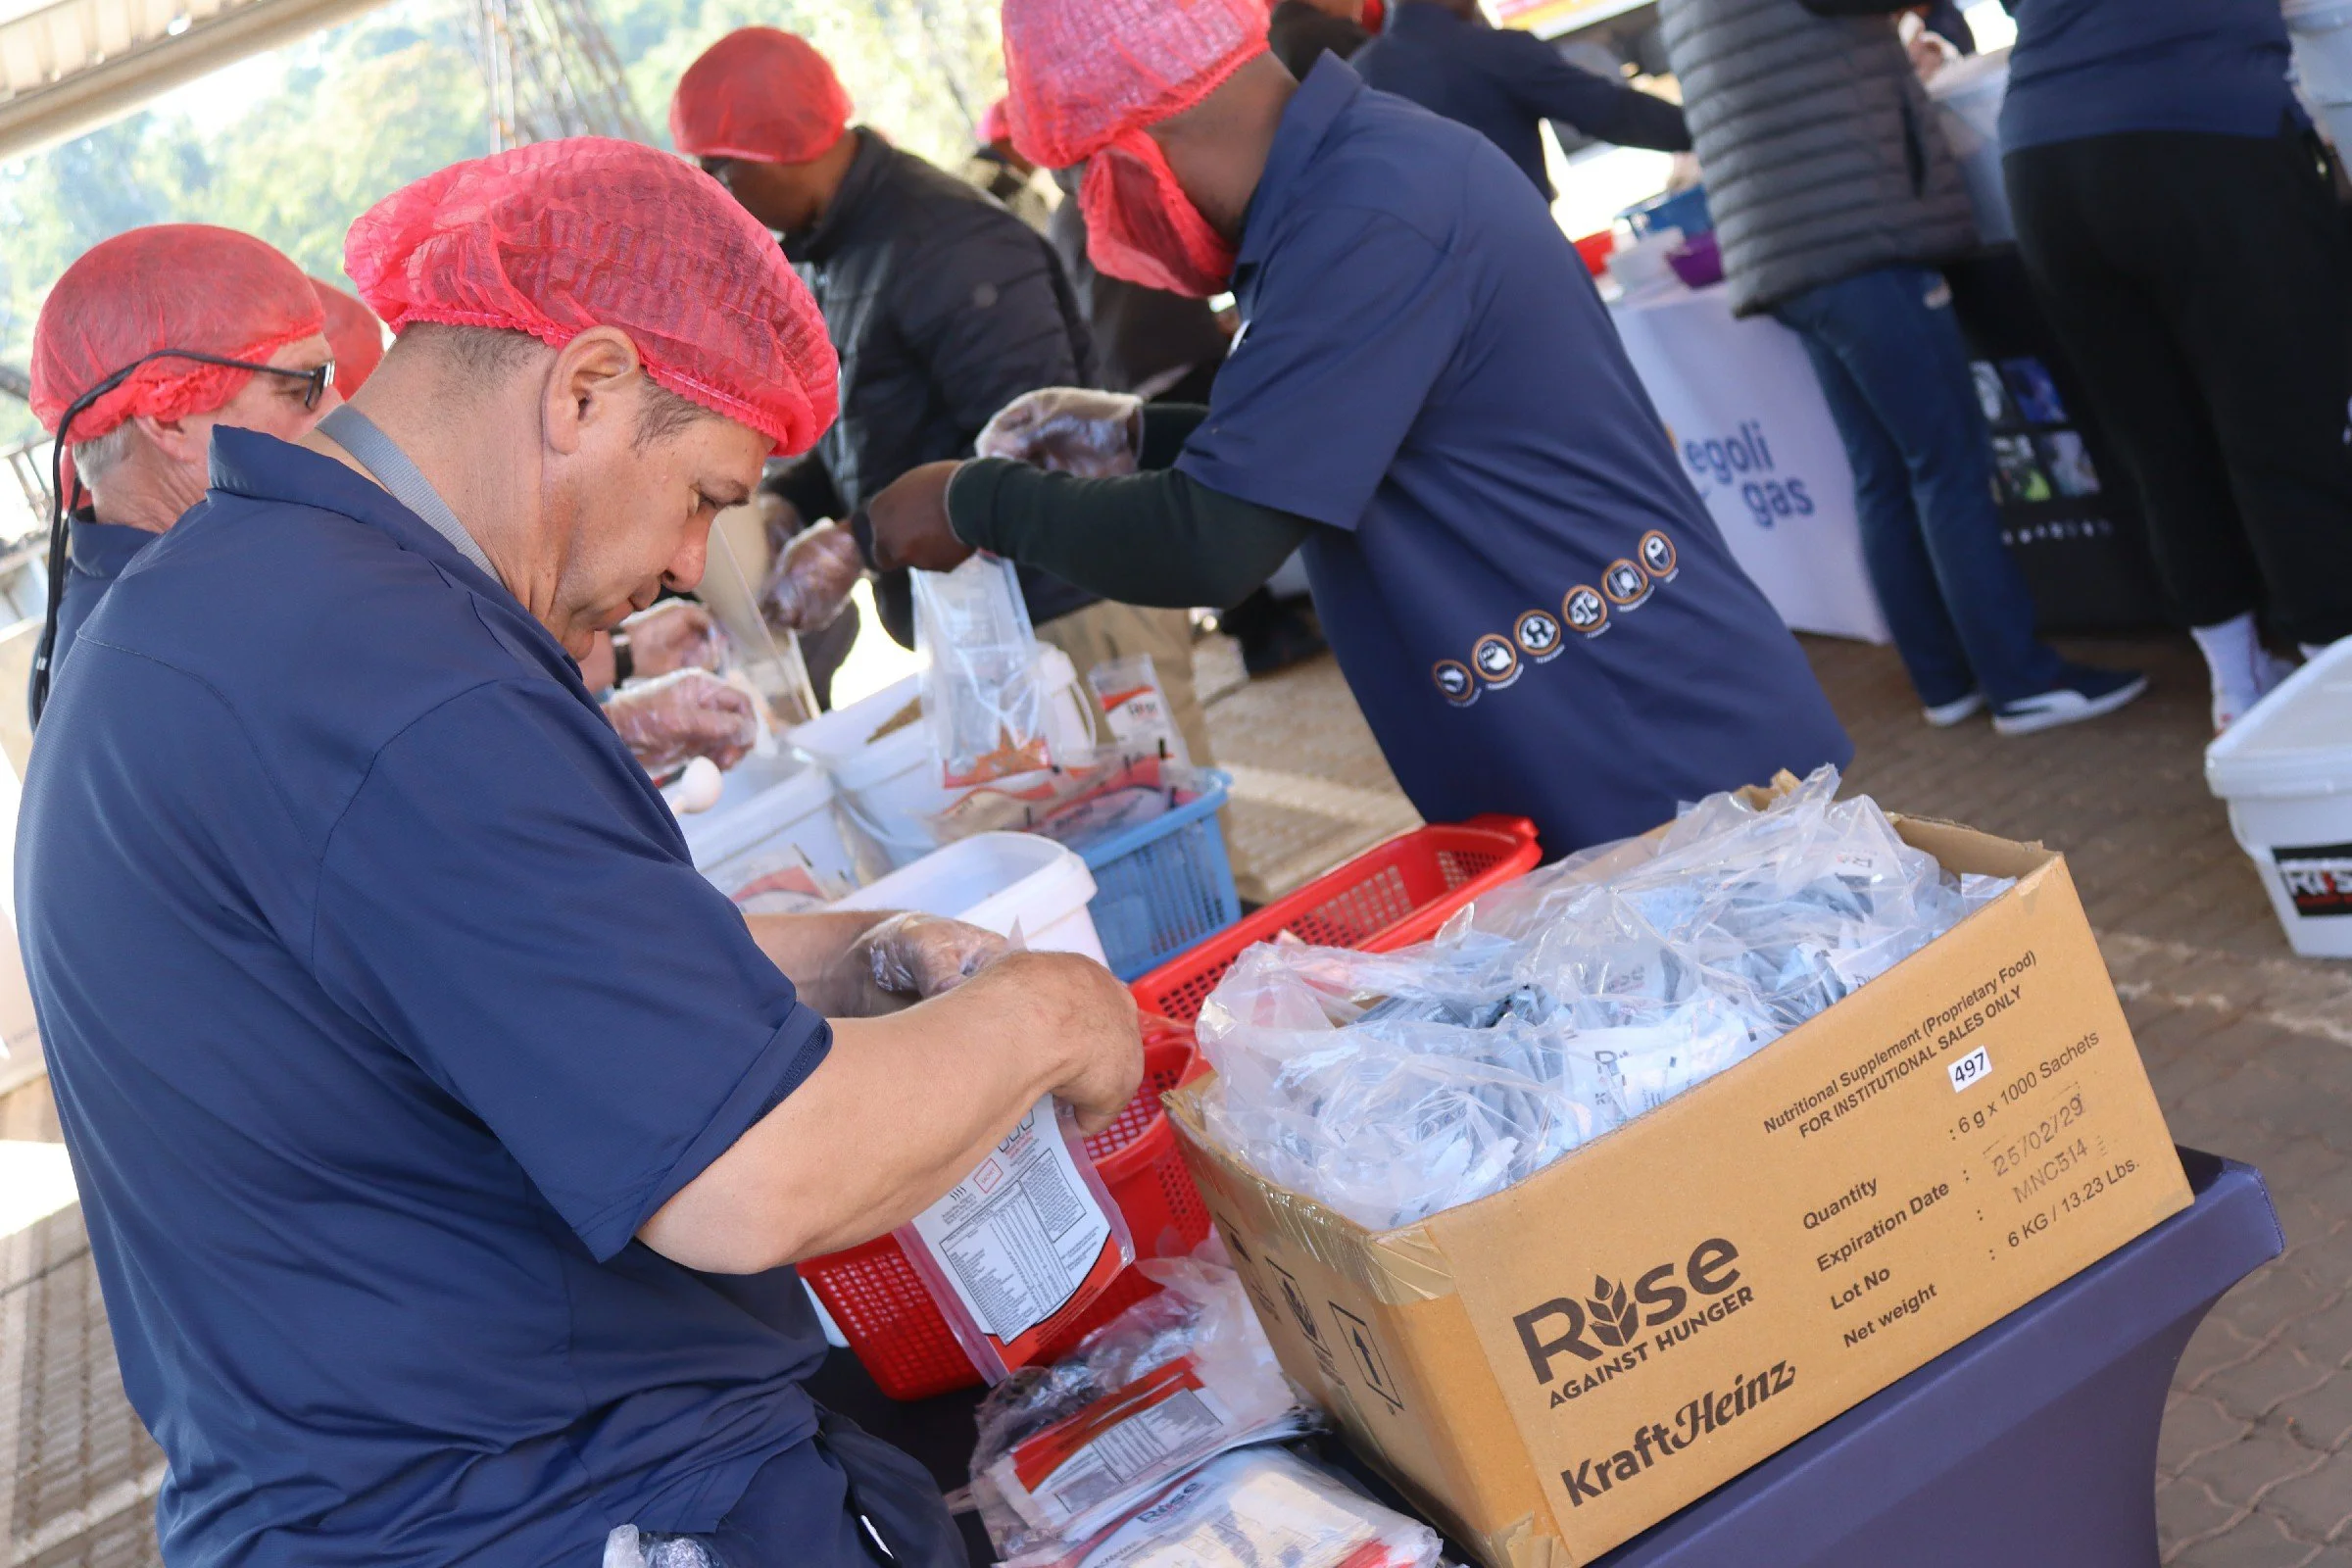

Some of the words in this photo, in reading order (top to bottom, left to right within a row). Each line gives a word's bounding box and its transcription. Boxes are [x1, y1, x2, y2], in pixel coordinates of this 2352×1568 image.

[1684, 419, 1775, 484] egoli
[1741, 478, 1815, 527] gas
[1763, 1081, 1838, 1134] Nutritional
[1840, 1029, 1922, 1088] Supplement
[1923, 978, 1998, 1038] (Proprietary
[1998, 950, 2036, 985] Food)
[1798, 1109, 1834, 1139] FOR
[1834, 1045, 1937, 1118] INSTITUTIONAL
[1937, 1011, 1984, 1051] SALES
[1985, 985, 2024, 1018] ONLY
[1954, 1052, 1985, 1083] 497
[1802, 1177, 1878, 1230] Quantity
[1987, 1102, 1998, 1117] x
[2000, 1071, 2037, 1105] 1000
[2039, 1031, 2099, 1078] Sachets
[1816, 1210, 1907, 1272] Expiration
[1909, 1183, 1949, 1215] Date
[1991, 1092, 2084, 1177] 25/02/29
[1831, 1283, 1862, 1310] Lot
[1863, 1268, 1890, 1291] No
[2012, 1138, 2088, 1203] MNC514
[1843, 1321, 1876, 1348] Net
[1878, 1283, 1937, 1327] weight
[2008, 1231, 2020, 1248] 6
[2022, 1213, 2049, 1240] KG
[2061, 1177, 2104, 1213] 13.23
[2106, 1157, 2139, 1185] Lbs.
[1549, 1342, 1648, 1409] AGAINST
[1655, 1286, 1755, 1351] HUNGER
[1560, 1359, 1796, 1507] KraftHeinz
